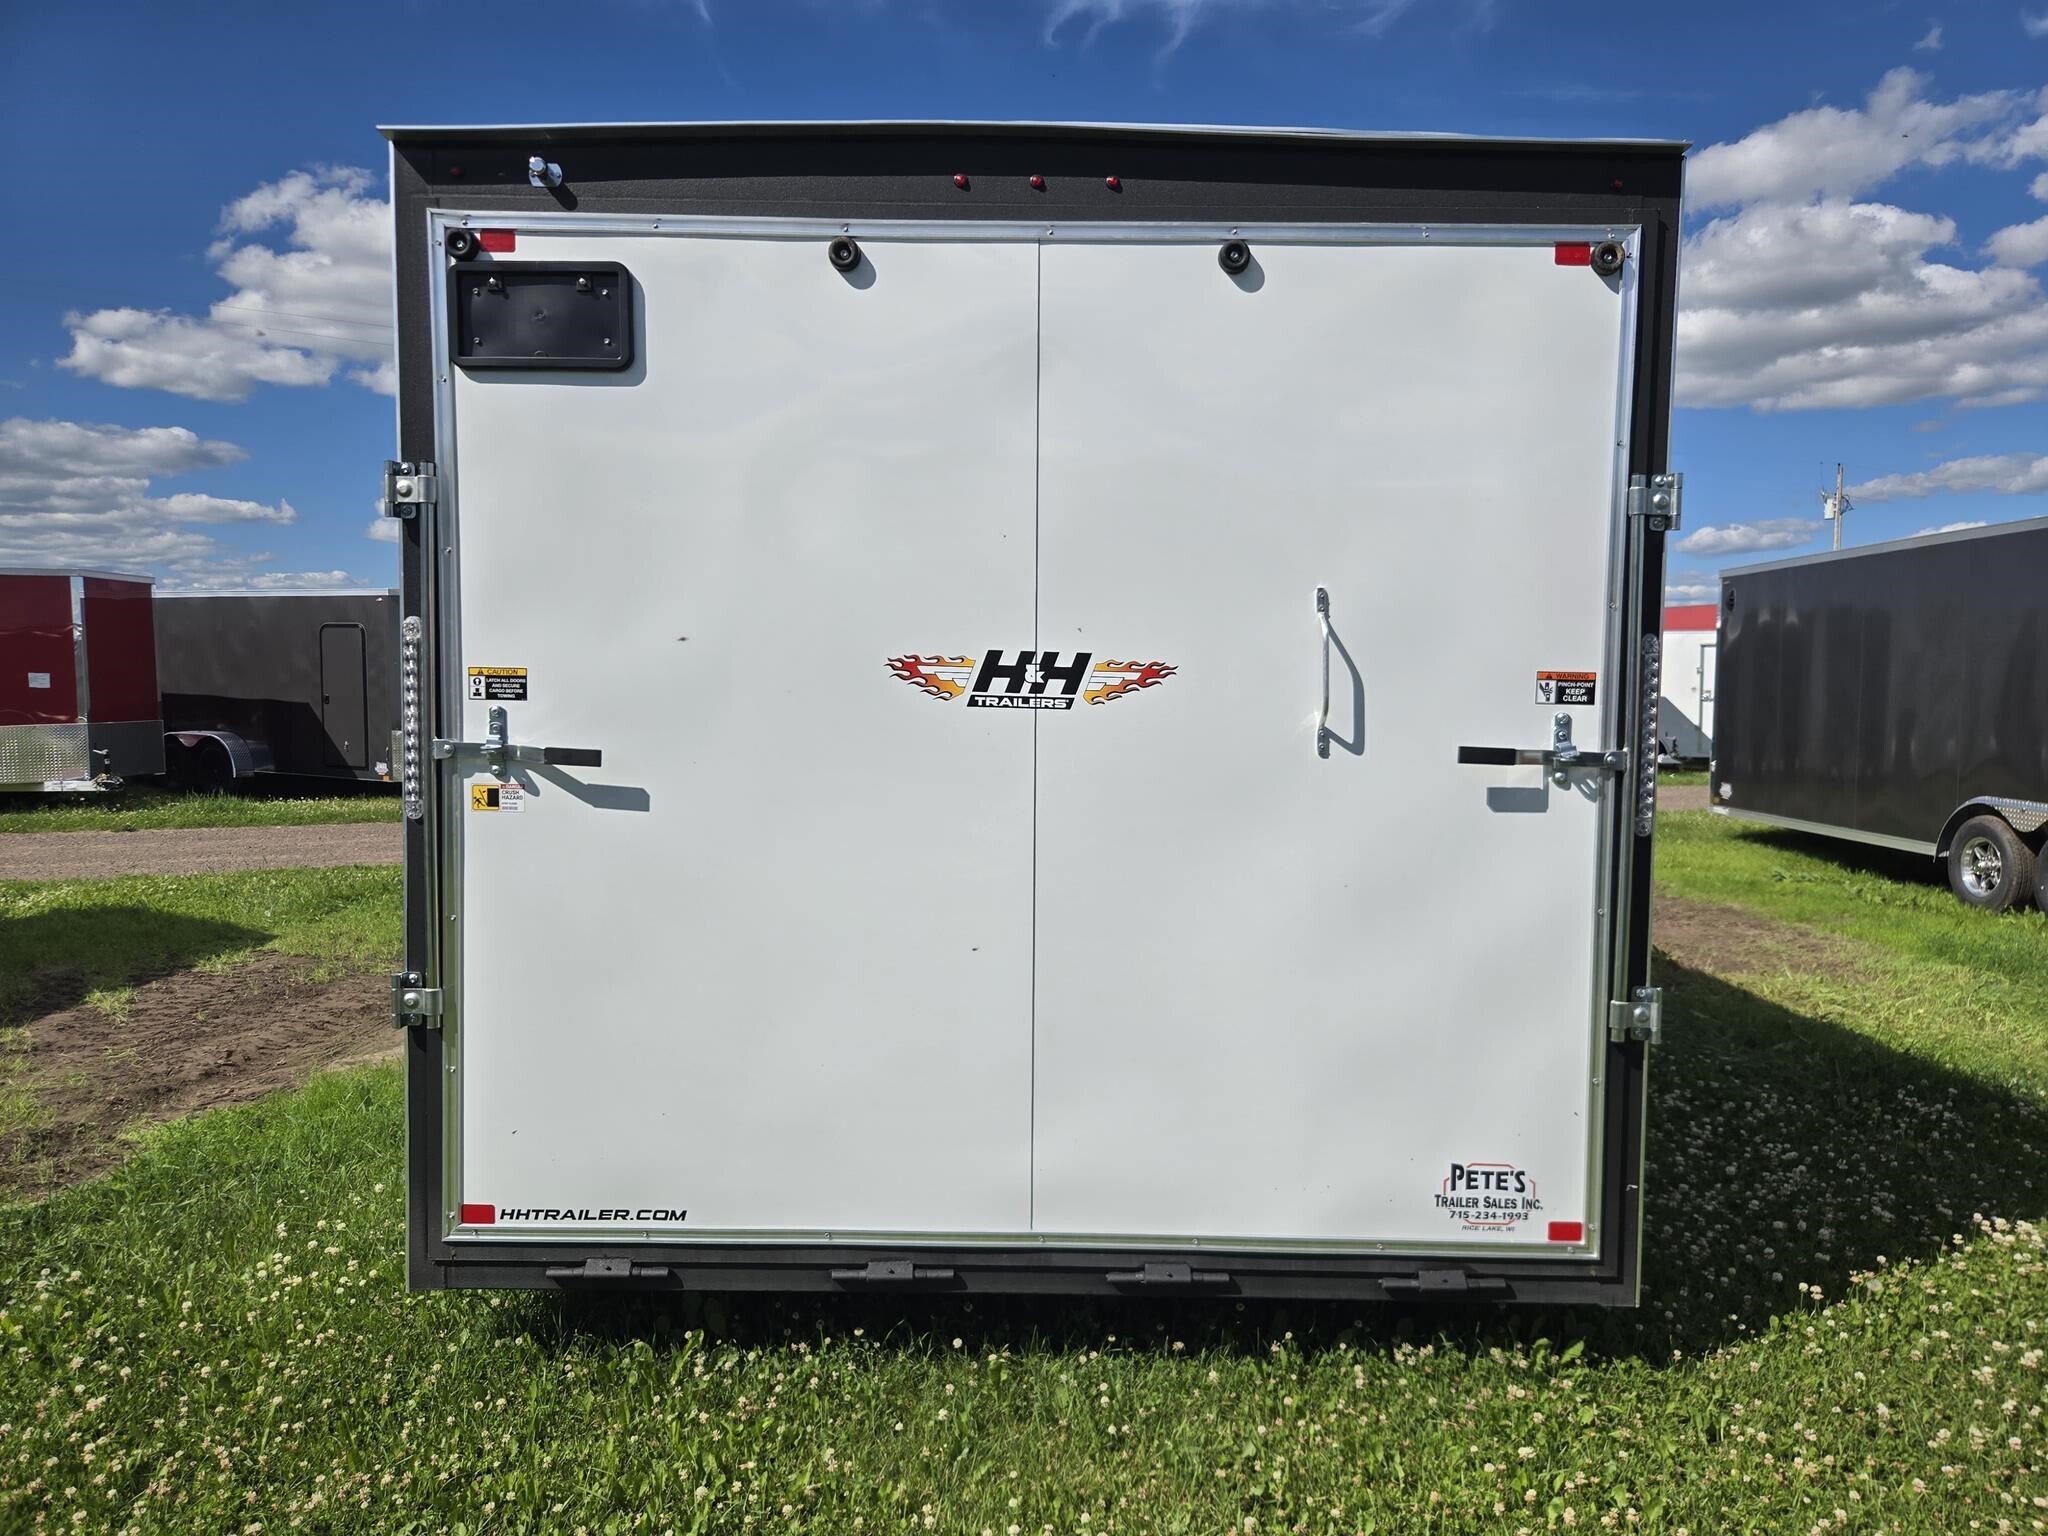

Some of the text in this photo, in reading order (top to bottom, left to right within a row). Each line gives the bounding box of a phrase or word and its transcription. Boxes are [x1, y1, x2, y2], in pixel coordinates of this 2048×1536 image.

[972, 649, 1092, 695] H&H
[974, 696, 1068, 708] TRAILERS
[1450, 1163, 1526, 1193] PETE'S
[1434, 1194, 1544, 1211] TRAILER SALES INC.
[499, 1208, 688, 1222] HHTRAILER.COM
[1449, 1210, 1529, 1221] 715-234-1993
